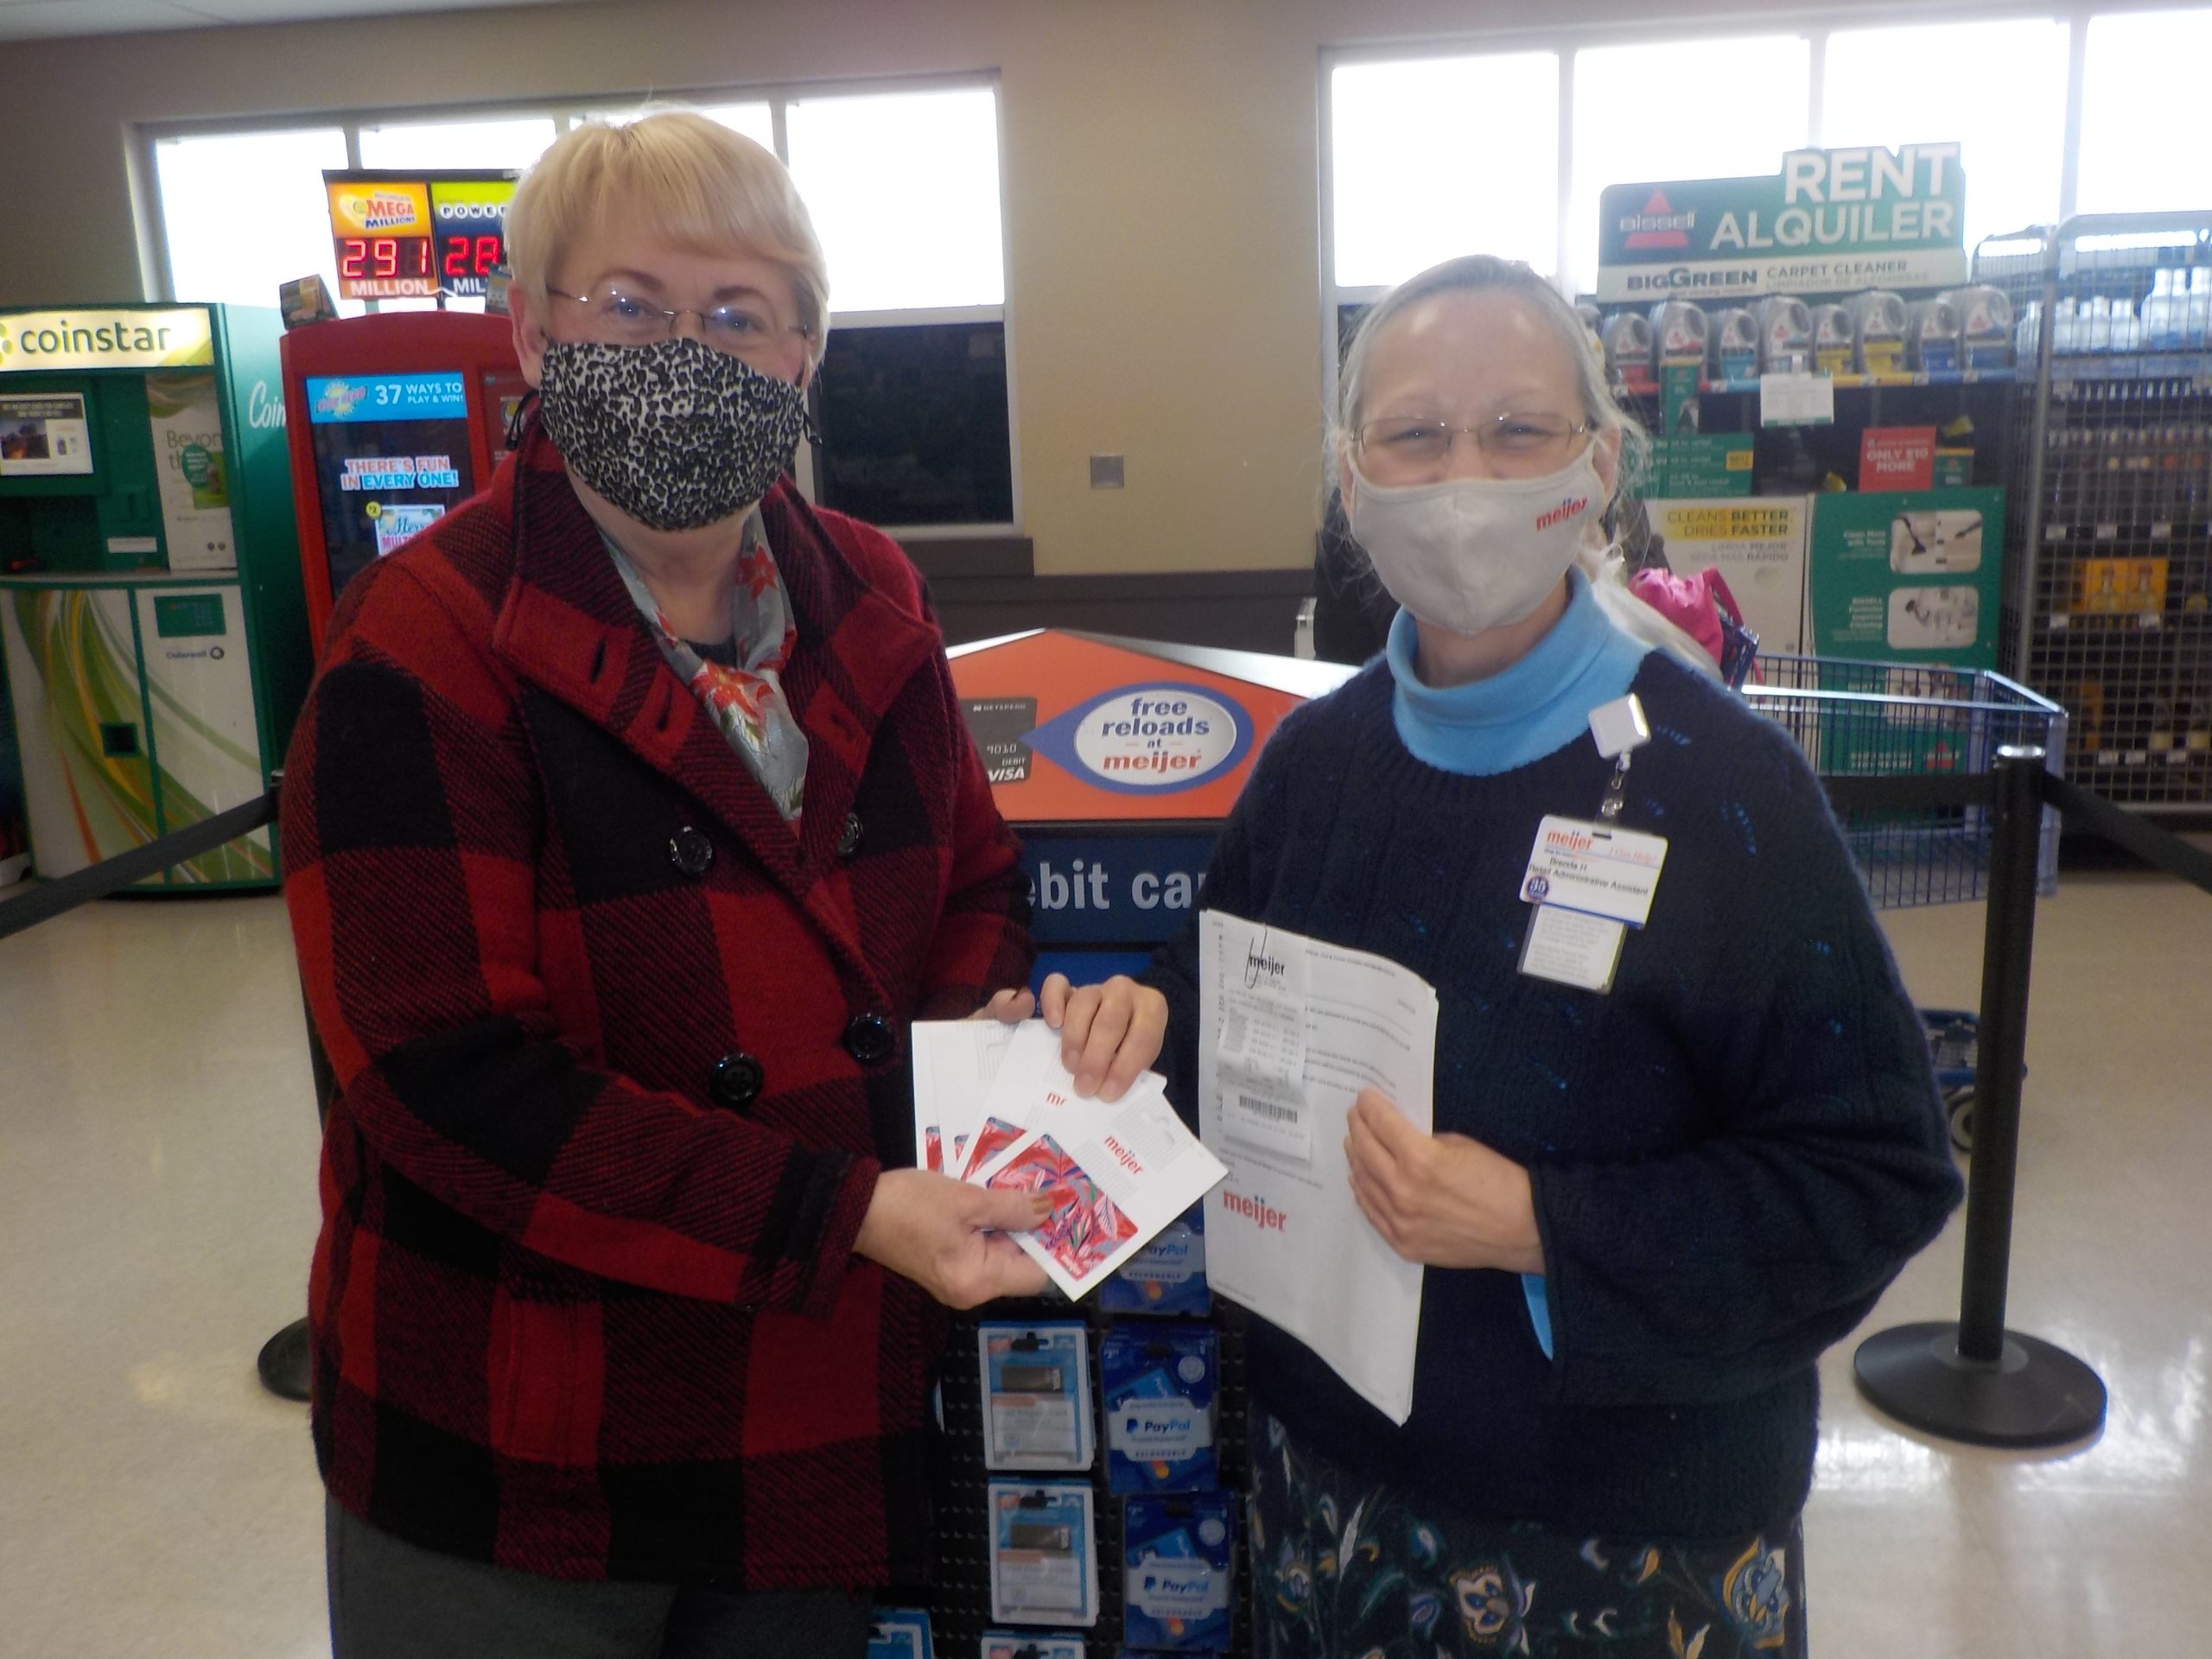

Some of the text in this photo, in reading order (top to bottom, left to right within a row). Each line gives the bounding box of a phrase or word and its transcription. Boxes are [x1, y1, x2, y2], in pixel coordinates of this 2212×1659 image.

[1785, 144, 1958, 205] RENT
[365, 200, 415, 217] MEGA
[1709, 200, 1955, 251] ALQUILER
[342, 239, 428, 277] 291
[1767, 261, 1907, 278] CARPET CLEANER
[350, 280, 429, 296] MILLION
[453, 277, 488, 294] MIL
[21, 320, 171, 353] coinstar
[375, 385, 402, 405] 37
[406, 382, 442, 395] WAYS
[445, 382, 463, 393] TO
[346, 456, 449, 474] THERE'S FUN
[342, 472, 458, 490] IN EVERY ONE!
[1536, 498, 1587, 531] meijer
[1731, 510, 1789, 522] BETTER
[1731, 524, 1789, 536] FASTER
[1131, 697, 1188, 716] free
[1102, 717, 1210, 737] reloads
[1147, 739, 1162, 749] at
[1103, 751, 1202, 773] meijer
[988, 766, 1025, 782] VISA
[1547, 830, 1593, 850] meijer
[1131, 872, 1207, 910] ca
[1249, 955, 1285, 976] meijer
[1104, 1135, 1143, 1175] meijer
[1224, 1190, 1286, 1230] meijer
[1147, 1244, 1189, 1257] ayPal
[1145, 1420, 1191, 1434] PayPal
[1163, 1579, 1209, 1593] PayPal
